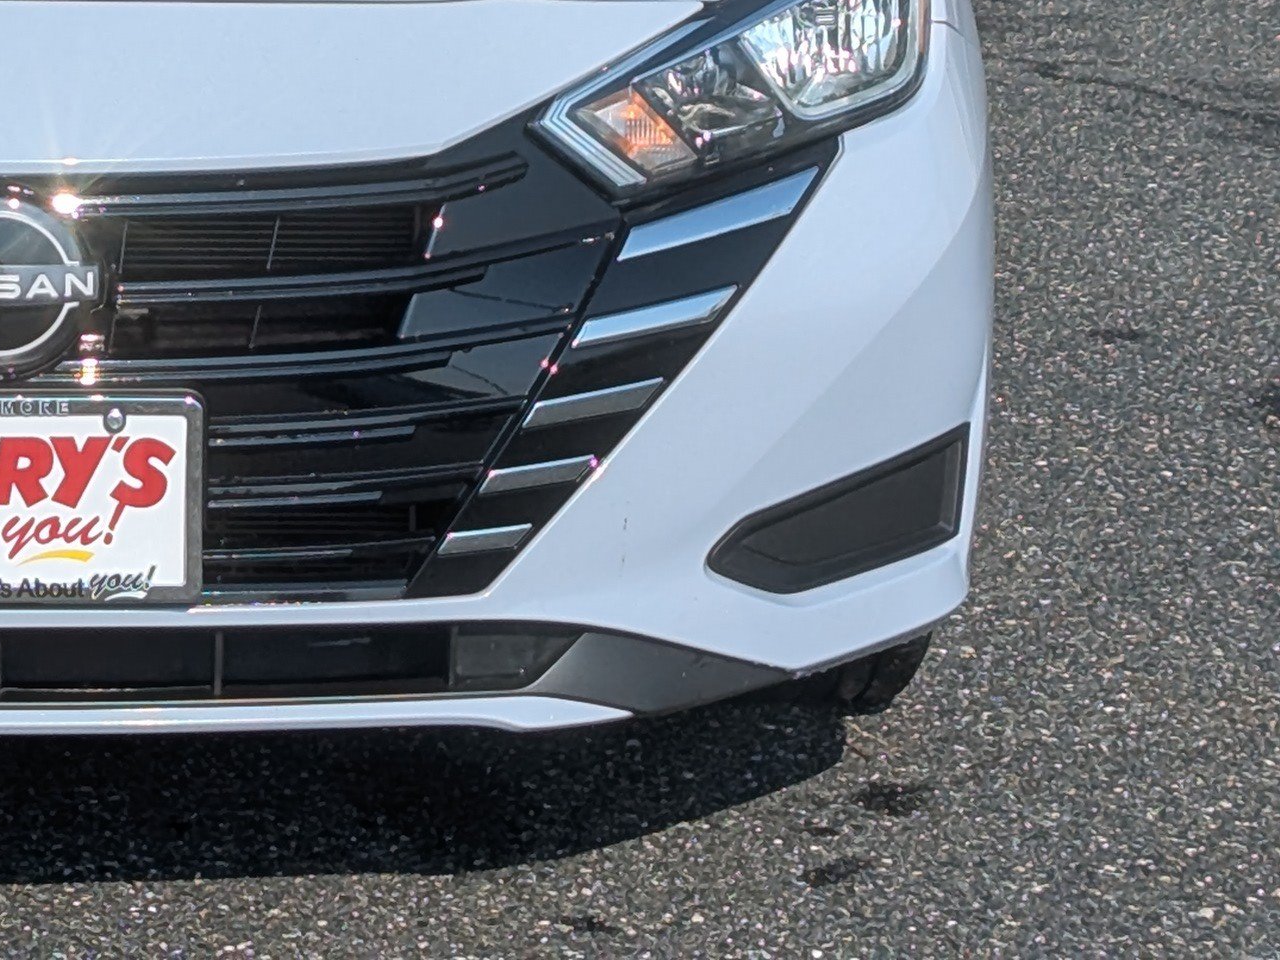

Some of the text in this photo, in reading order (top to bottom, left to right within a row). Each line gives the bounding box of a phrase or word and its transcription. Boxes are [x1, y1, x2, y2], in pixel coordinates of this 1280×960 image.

[1, 504, 125, 560] you!
[18, 577, 85, 599] About
[89, 565, 156, 600] you!
